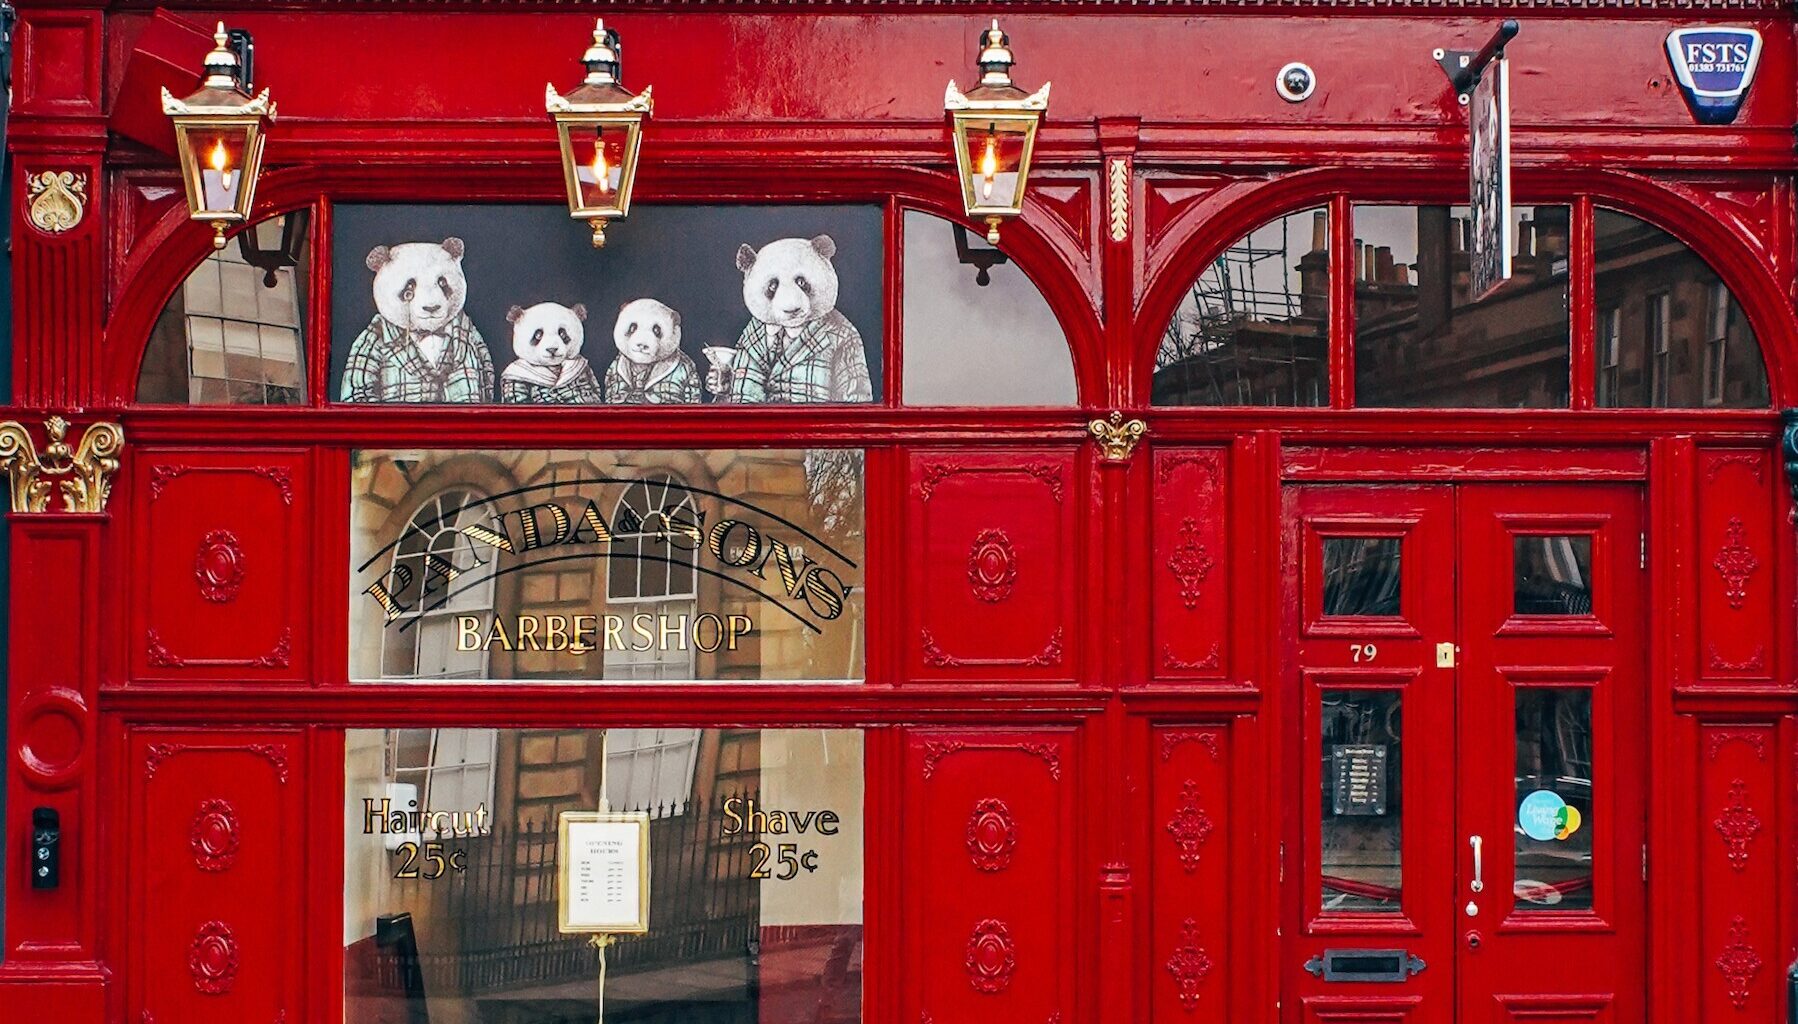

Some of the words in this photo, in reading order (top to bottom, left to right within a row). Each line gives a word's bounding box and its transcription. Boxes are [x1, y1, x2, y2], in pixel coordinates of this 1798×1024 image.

[1686, 43, 1748, 63] FSTS
[1715, 63, 1745, 72] 731761
[361, 499, 625, 627] PANDA
[655, 505, 854, 621] SONS
[456, 613, 754, 654] BARBERSHOP
[1350, 643, 1377, 662] 79
[362, 798, 489, 836] Haircut
[722, 797, 840, 835] Shave
[394, 841, 467, 880] 25¢
[748, 841, 819, 880] 25¢
